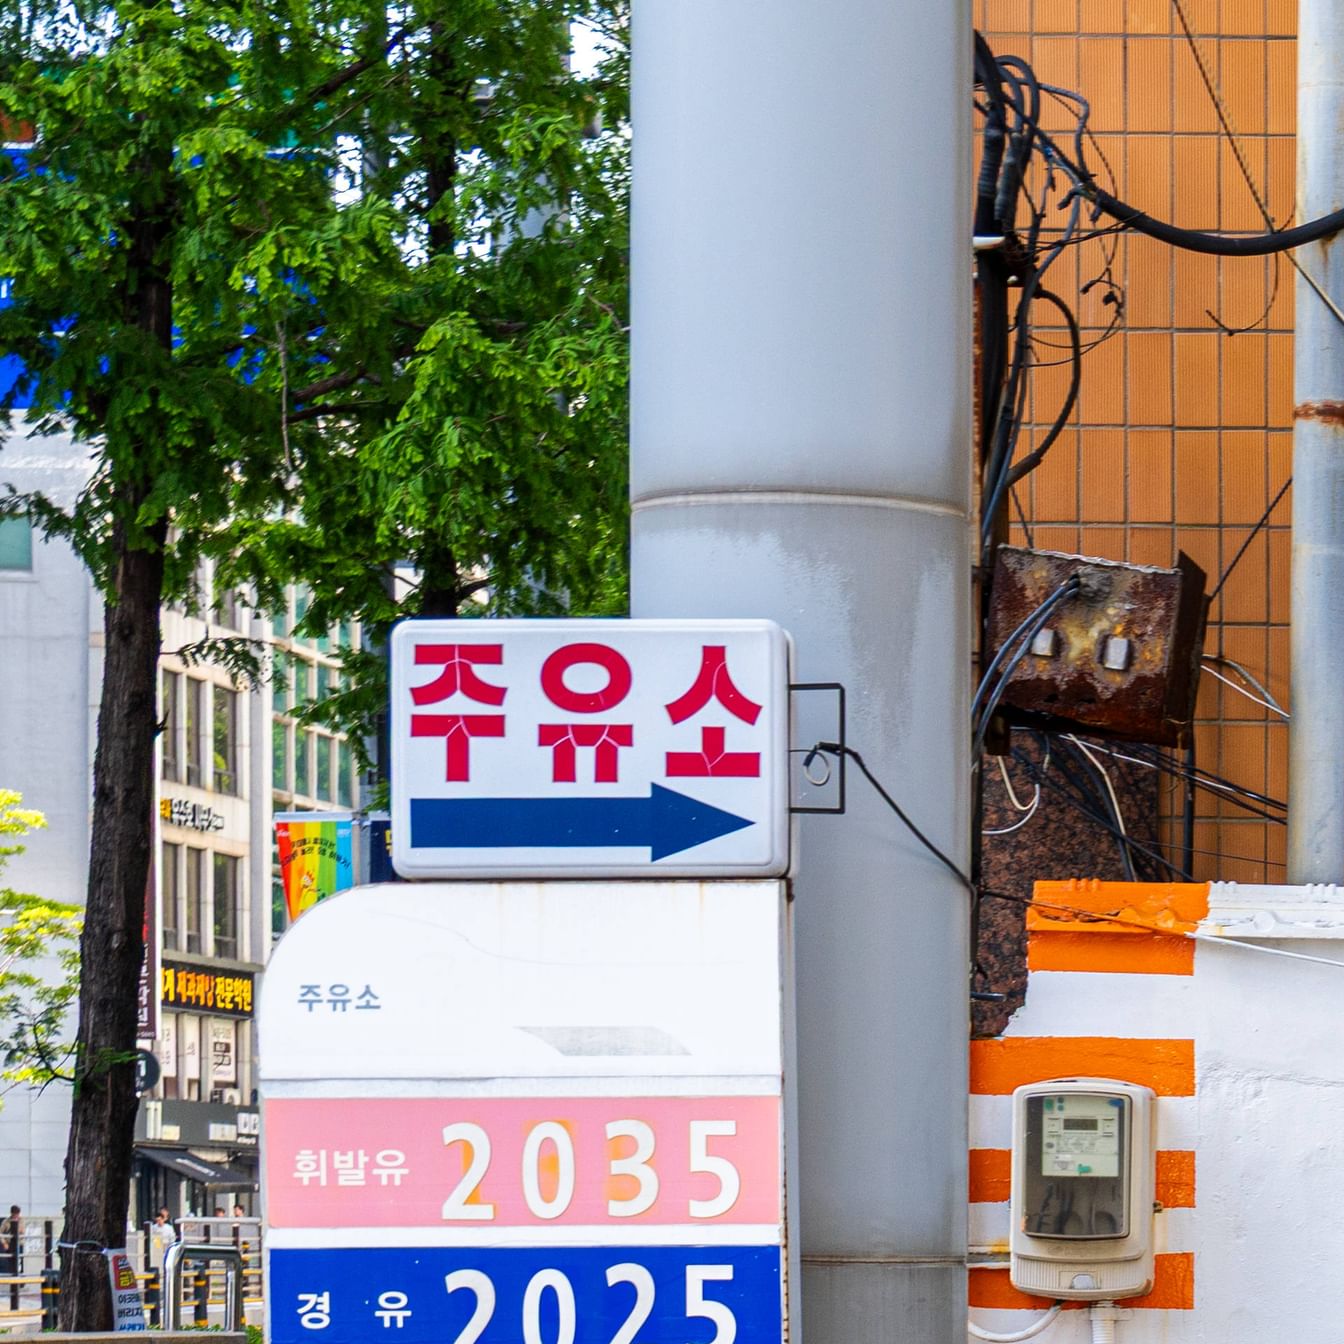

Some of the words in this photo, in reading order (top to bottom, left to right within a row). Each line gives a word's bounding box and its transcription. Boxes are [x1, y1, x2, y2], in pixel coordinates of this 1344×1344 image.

[410, 642, 763, 783] 주유소
[297, 984, 382, 1013] 주유소
[292, 1148, 410, 1188] 휘발유
[441, 1120, 743, 1222] 2035
